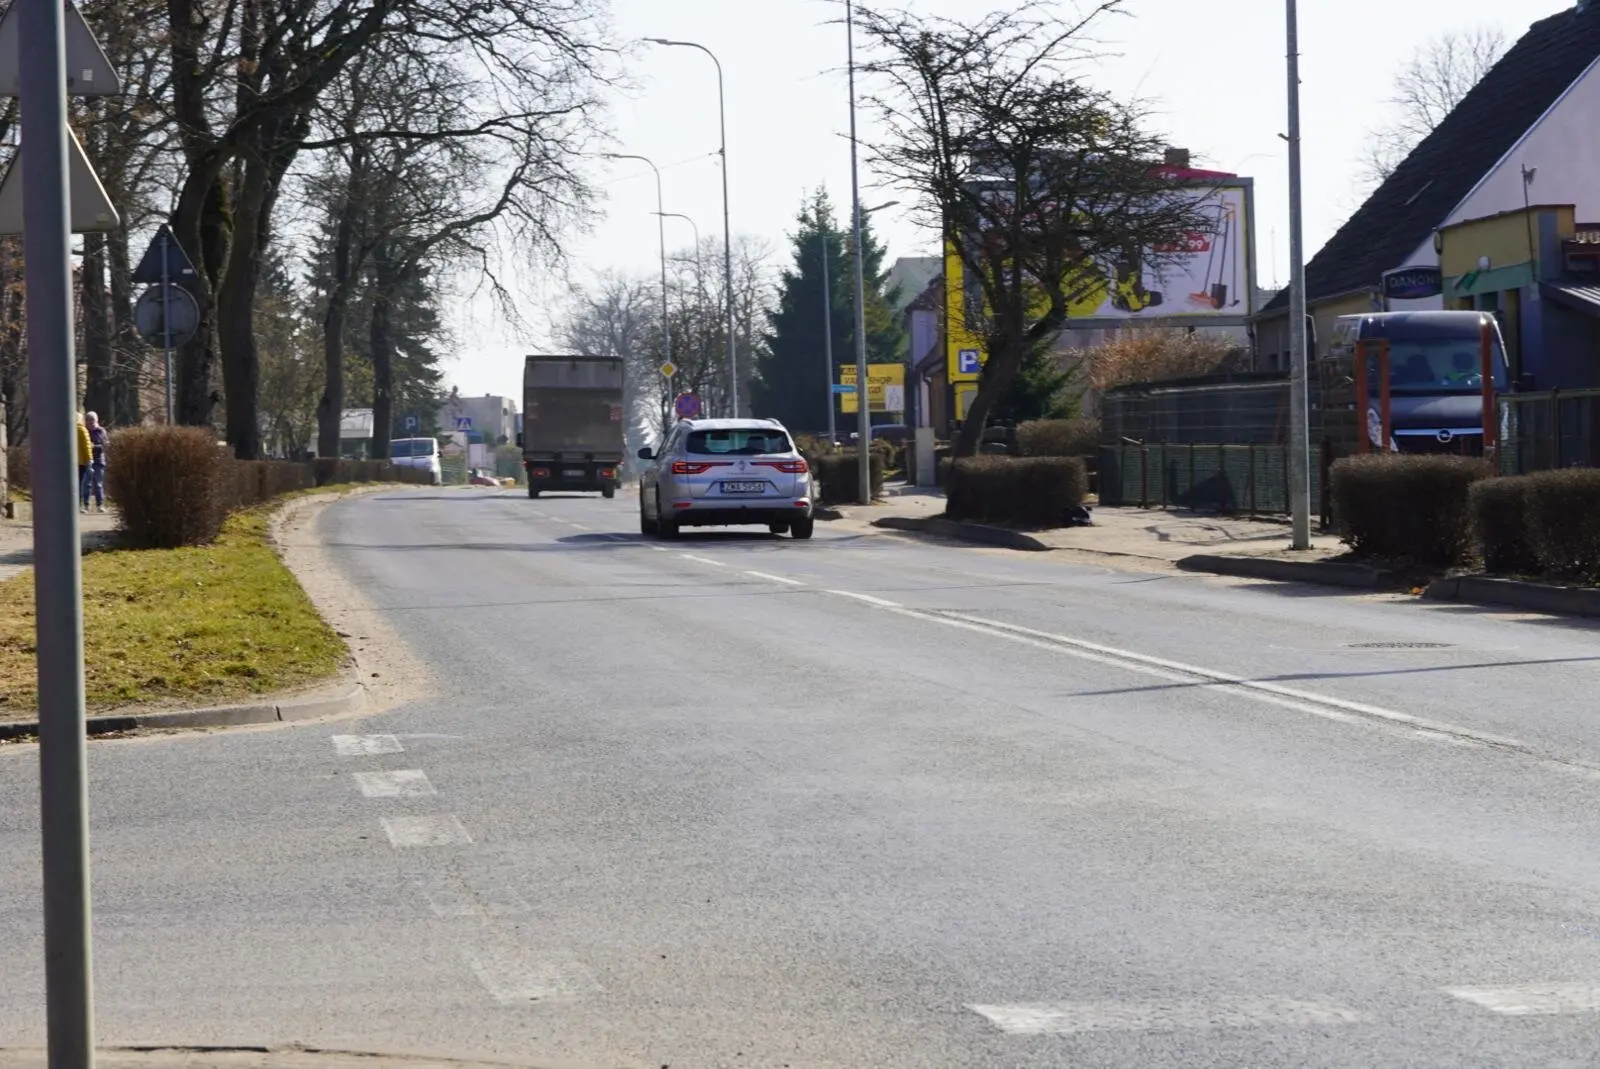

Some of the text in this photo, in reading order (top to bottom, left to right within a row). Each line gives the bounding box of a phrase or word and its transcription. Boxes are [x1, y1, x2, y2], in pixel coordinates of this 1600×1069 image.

[1389, 274, 1439, 289] DANON
[960, 350, 977, 373] P
[405, 416, 416, 430] P
